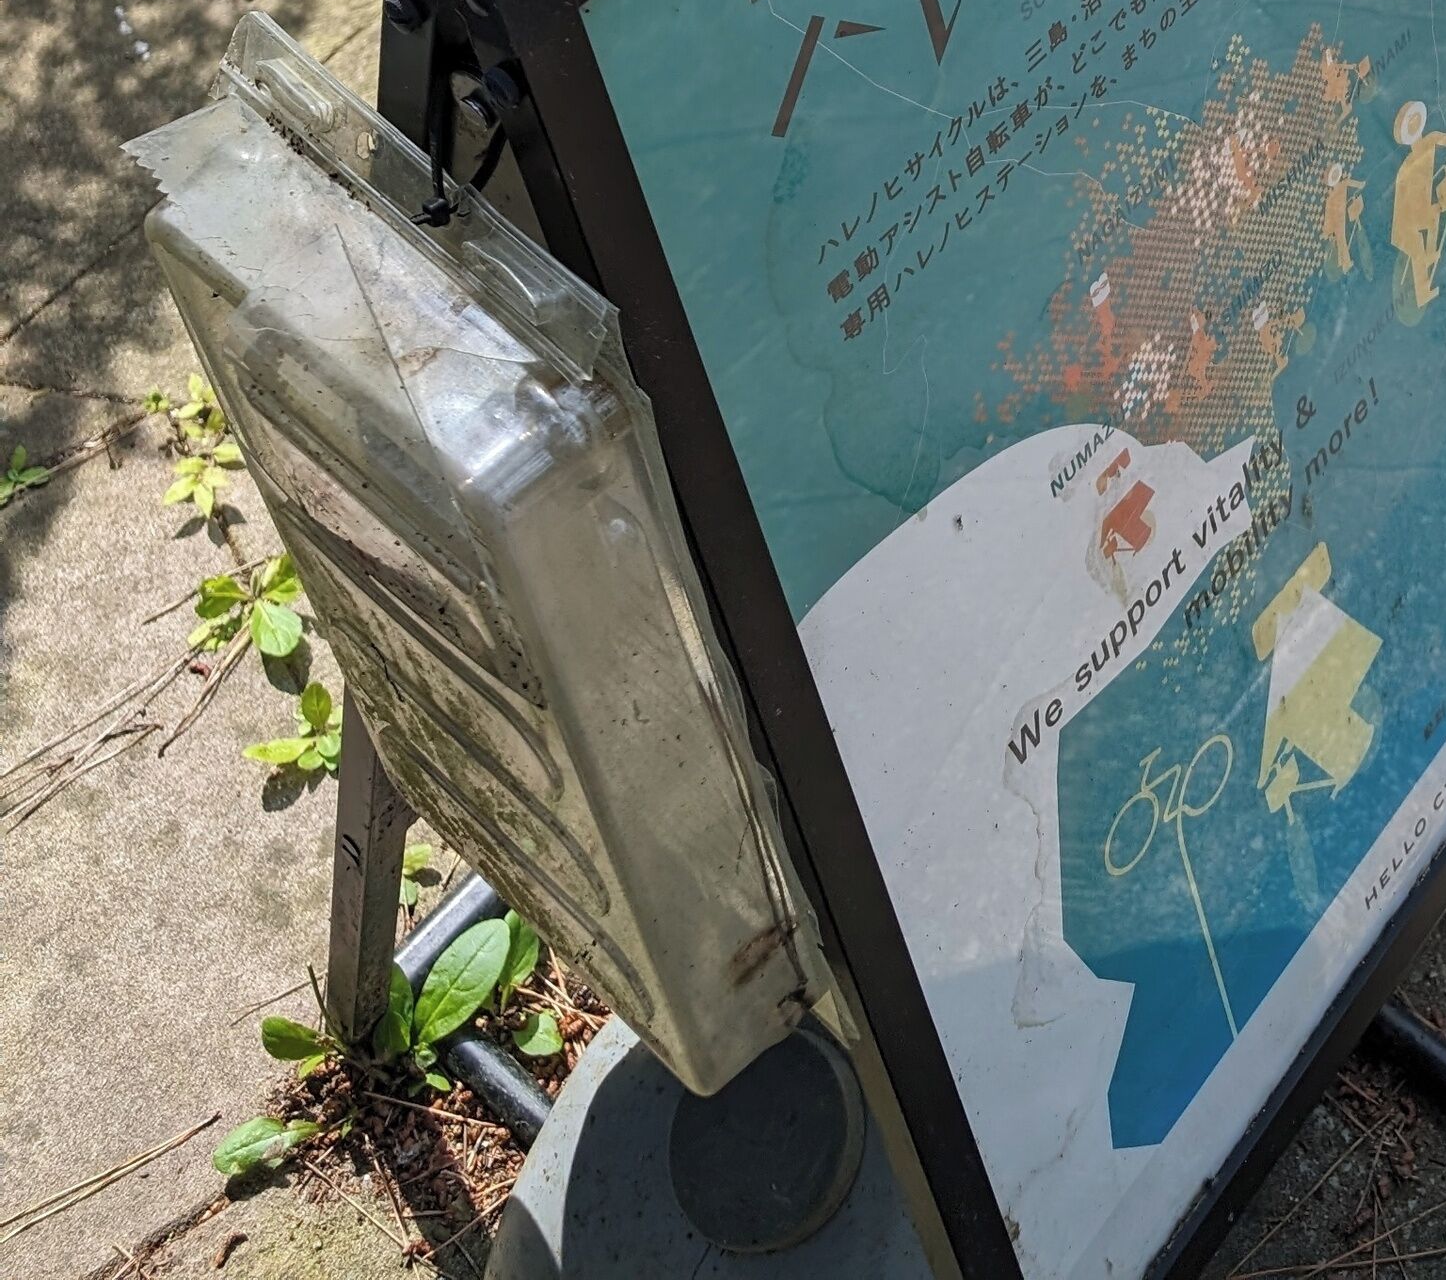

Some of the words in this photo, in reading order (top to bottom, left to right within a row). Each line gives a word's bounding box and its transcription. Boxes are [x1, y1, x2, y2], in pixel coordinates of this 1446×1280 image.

[1076, 153, 1176, 266] NAGAIZUMI
[1258, 141, 1325, 216] MISHIMA
[1333, 290, 1408, 385] IZUNOKUN
[1184, 486, 1293, 630] mobility
[1304, 377, 1380, 487] more!
[1007, 697, 1064, 765] We
[1074, 548, 1187, 692] support
[1191, 432, 1284, 550] vitality
[1294, 394, 1318, 430] &
[1365, 817, 1427, 911] HELLO
